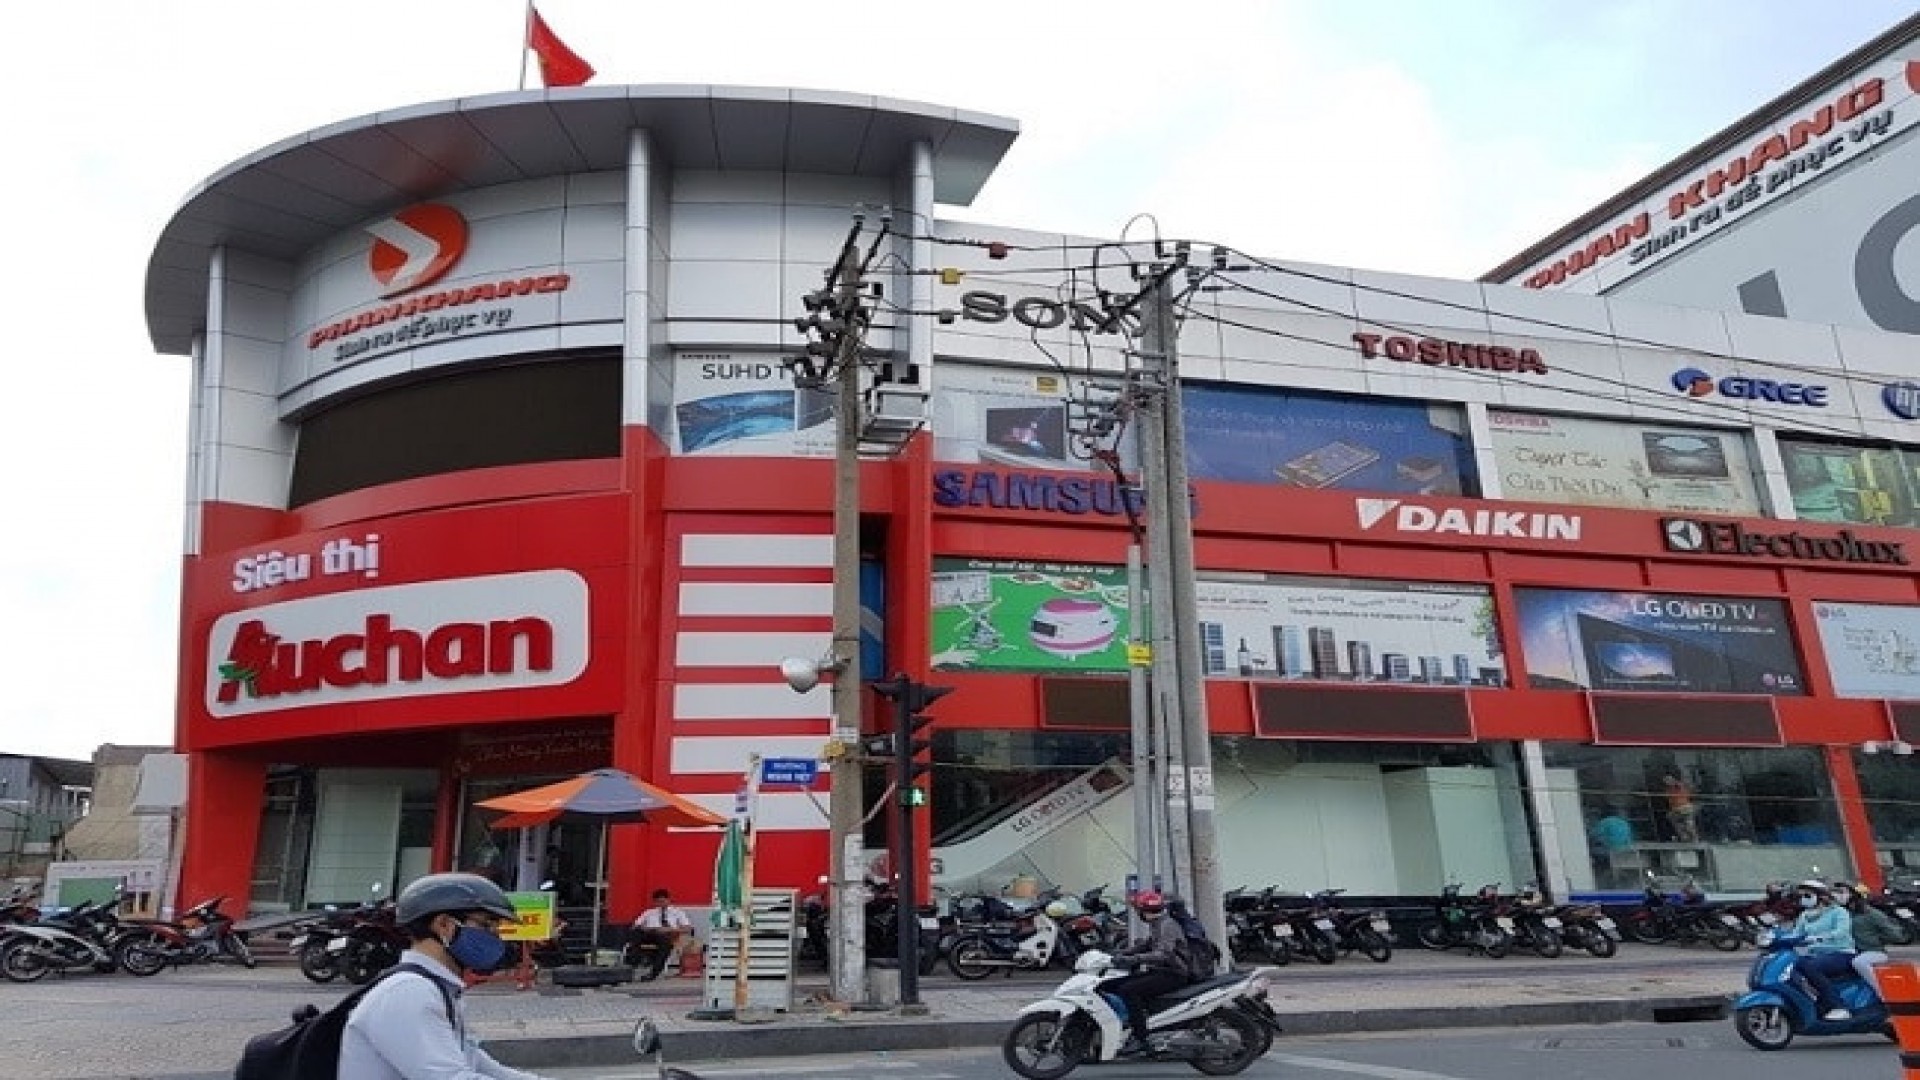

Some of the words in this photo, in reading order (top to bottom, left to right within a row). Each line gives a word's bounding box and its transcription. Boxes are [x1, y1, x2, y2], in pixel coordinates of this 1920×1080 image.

[1668, 77, 1885, 220] KHANG
[962, 290, 1146, 338] SON
[702, 363, 772, 380] SUHD
[1352, 331, 1549, 376] TOSHIBA
[1718, 376, 1829, 407] GREE
[934, 469, 1197, 518] SAMSU
[1396, 505, 1582, 540] DAIKIN
[1702, 520, 1910, 566] Electrolux
[232, 551, 311, 593] Siêu
[321, 533, 379, 578] thị
[1632, 599, 1662, 617] LG
[1728, 602, 1756, 620] TV
[215, 613, 554, 705] Auchan
